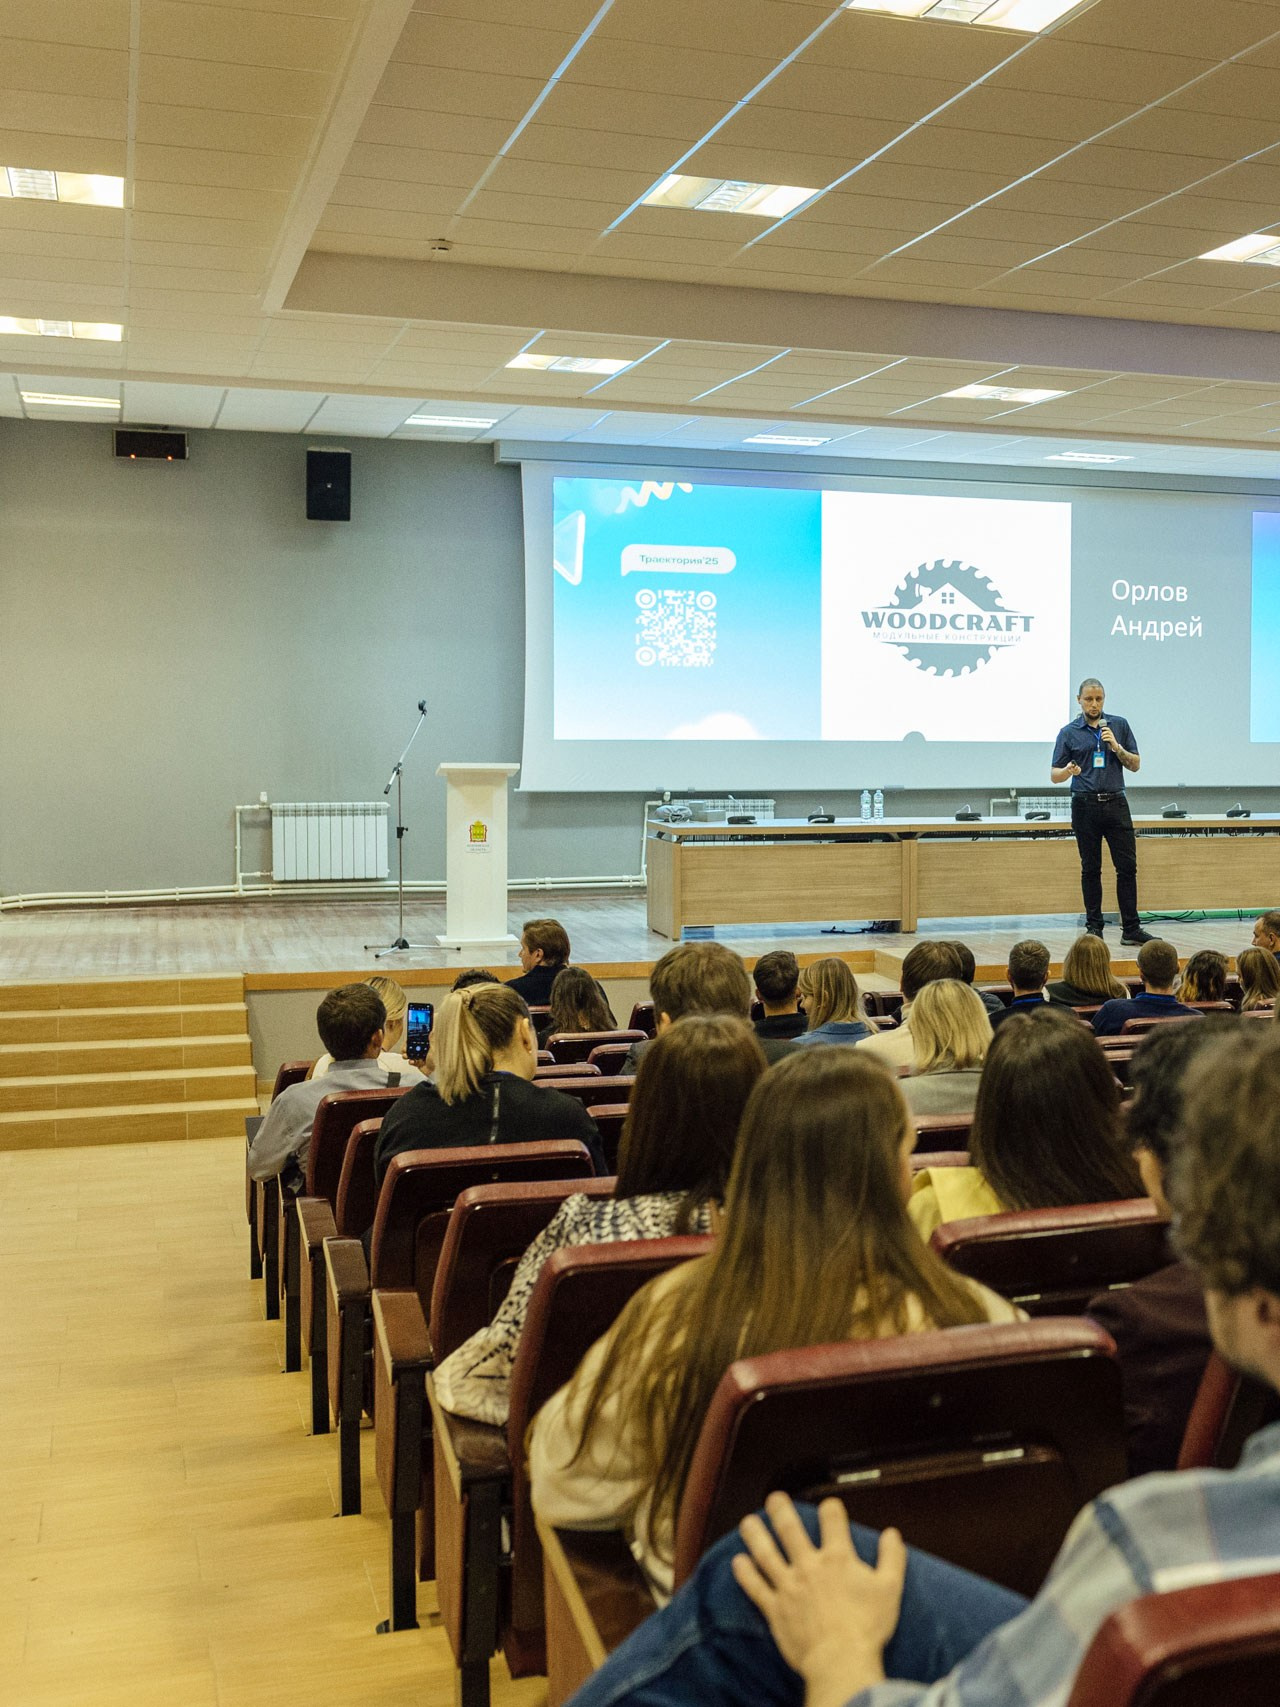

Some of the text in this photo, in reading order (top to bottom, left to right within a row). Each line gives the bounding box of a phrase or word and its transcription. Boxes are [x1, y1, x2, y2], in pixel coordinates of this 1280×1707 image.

[1112, 580, 1188, 605] Орлов
[861, 612, 1034, 632] WOODCRAFT
[1111, 615, 1202, 641] Андрей
[873, 632, 1022, 643] МОДУЛЬНЫЕ КОНСТРУКЦИИ
